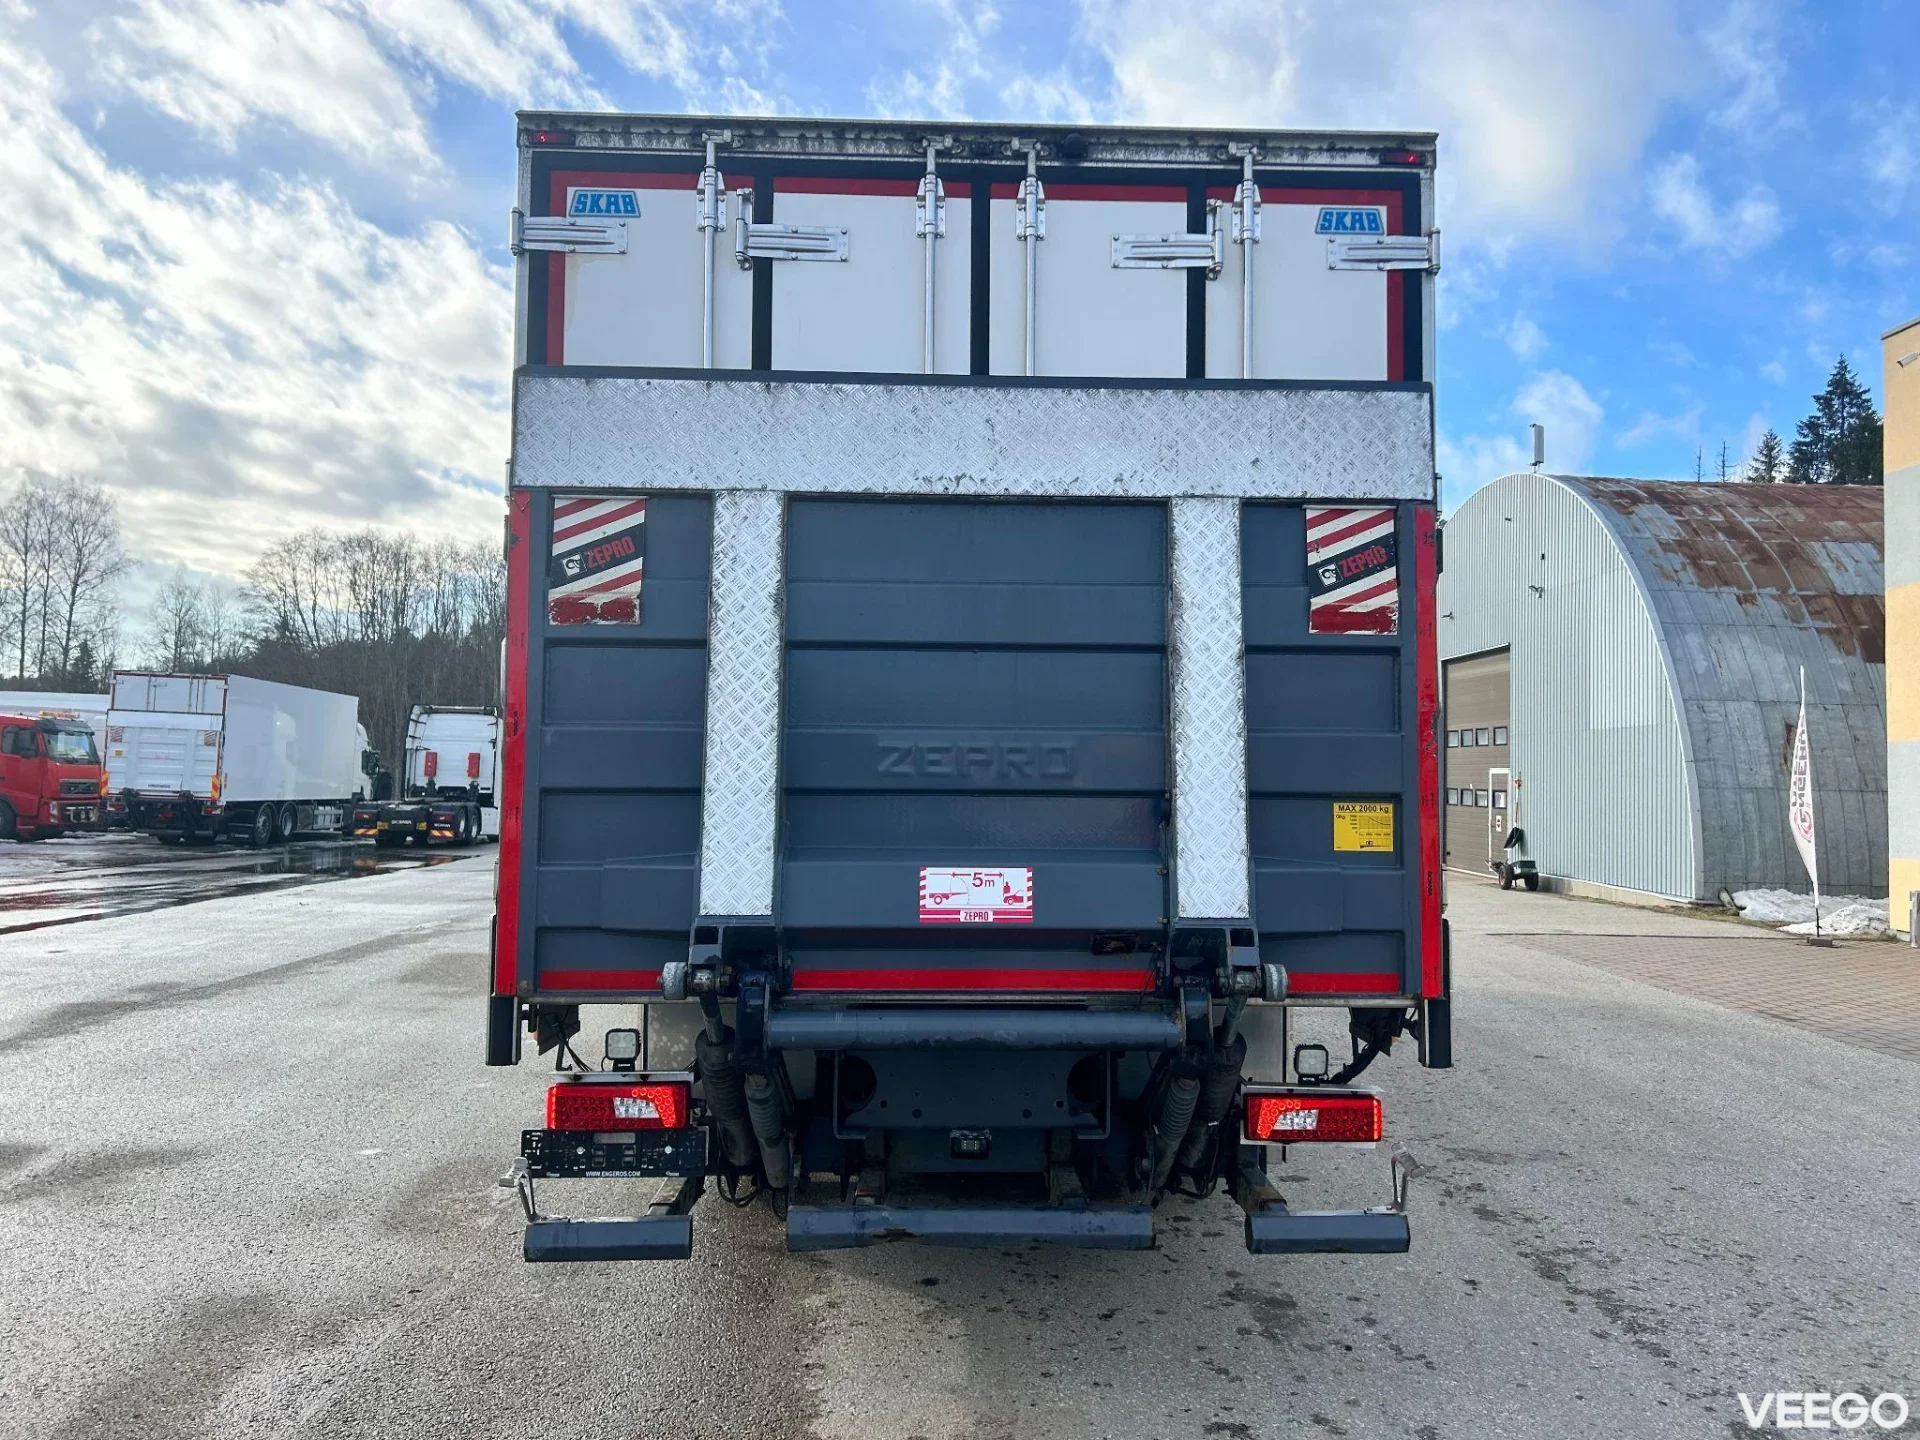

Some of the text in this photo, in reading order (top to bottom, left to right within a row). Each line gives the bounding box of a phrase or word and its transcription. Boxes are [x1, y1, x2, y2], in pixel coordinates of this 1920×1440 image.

[574, 193, 637, 214] SKAB
[1320, 211, 1381, 231] SKAB
[585, 536, 635, 568] ZEPRO
[1338, 545, 1388, 577] ZEPRO
[877, 741, 1077, 778] ZEPRO
[1379, 805, 1389, 814] kg
[972, 872, 995, 888] 5m
[963, 911, 989, 921] ZEPRO
